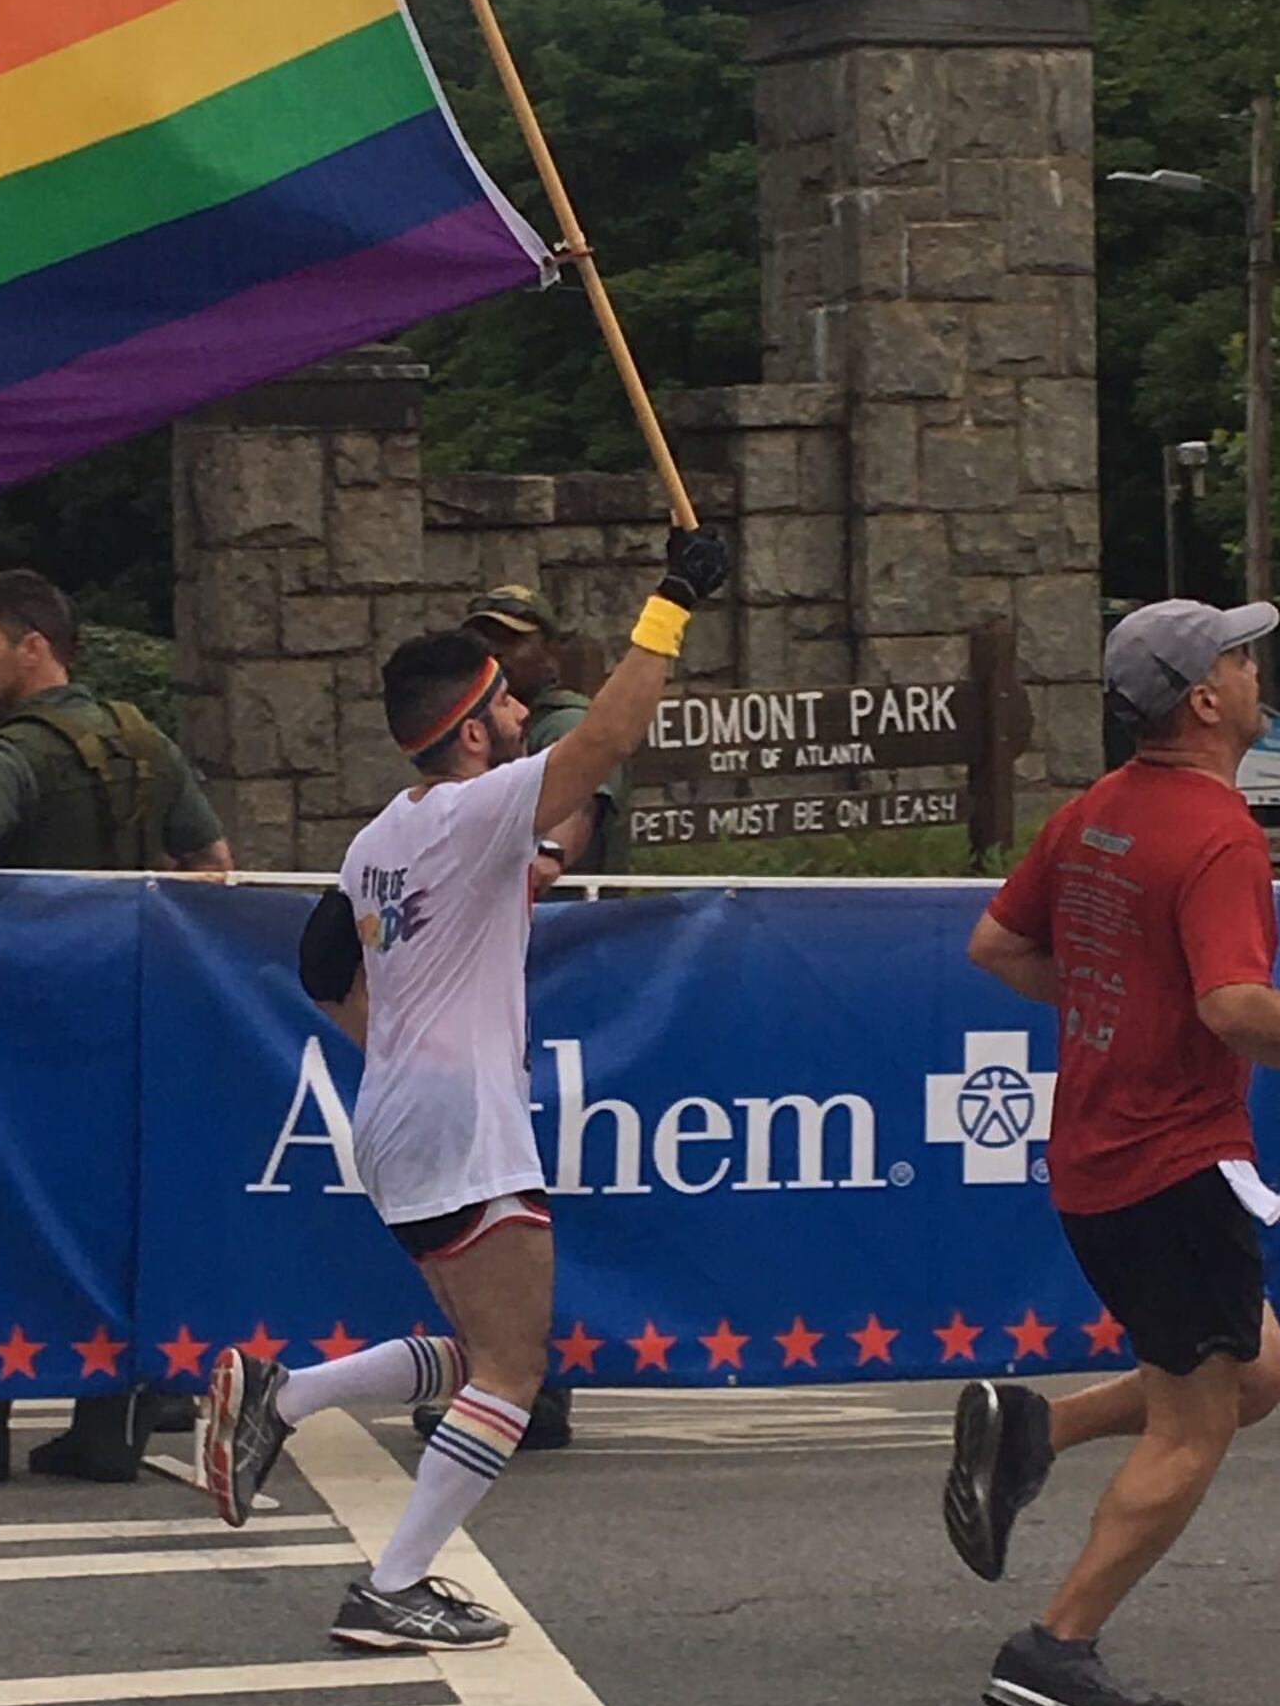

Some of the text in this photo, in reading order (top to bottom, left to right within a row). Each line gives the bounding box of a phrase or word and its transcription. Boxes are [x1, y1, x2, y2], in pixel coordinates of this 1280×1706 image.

[850, 686, 957, 737] PARK
[709, 743, 876, 773] CITY OF ATLANTA
[630, 794, 958, 842] PETS MUST BE ON LEASH
[245, 1035, 888, 1195] Ahem
